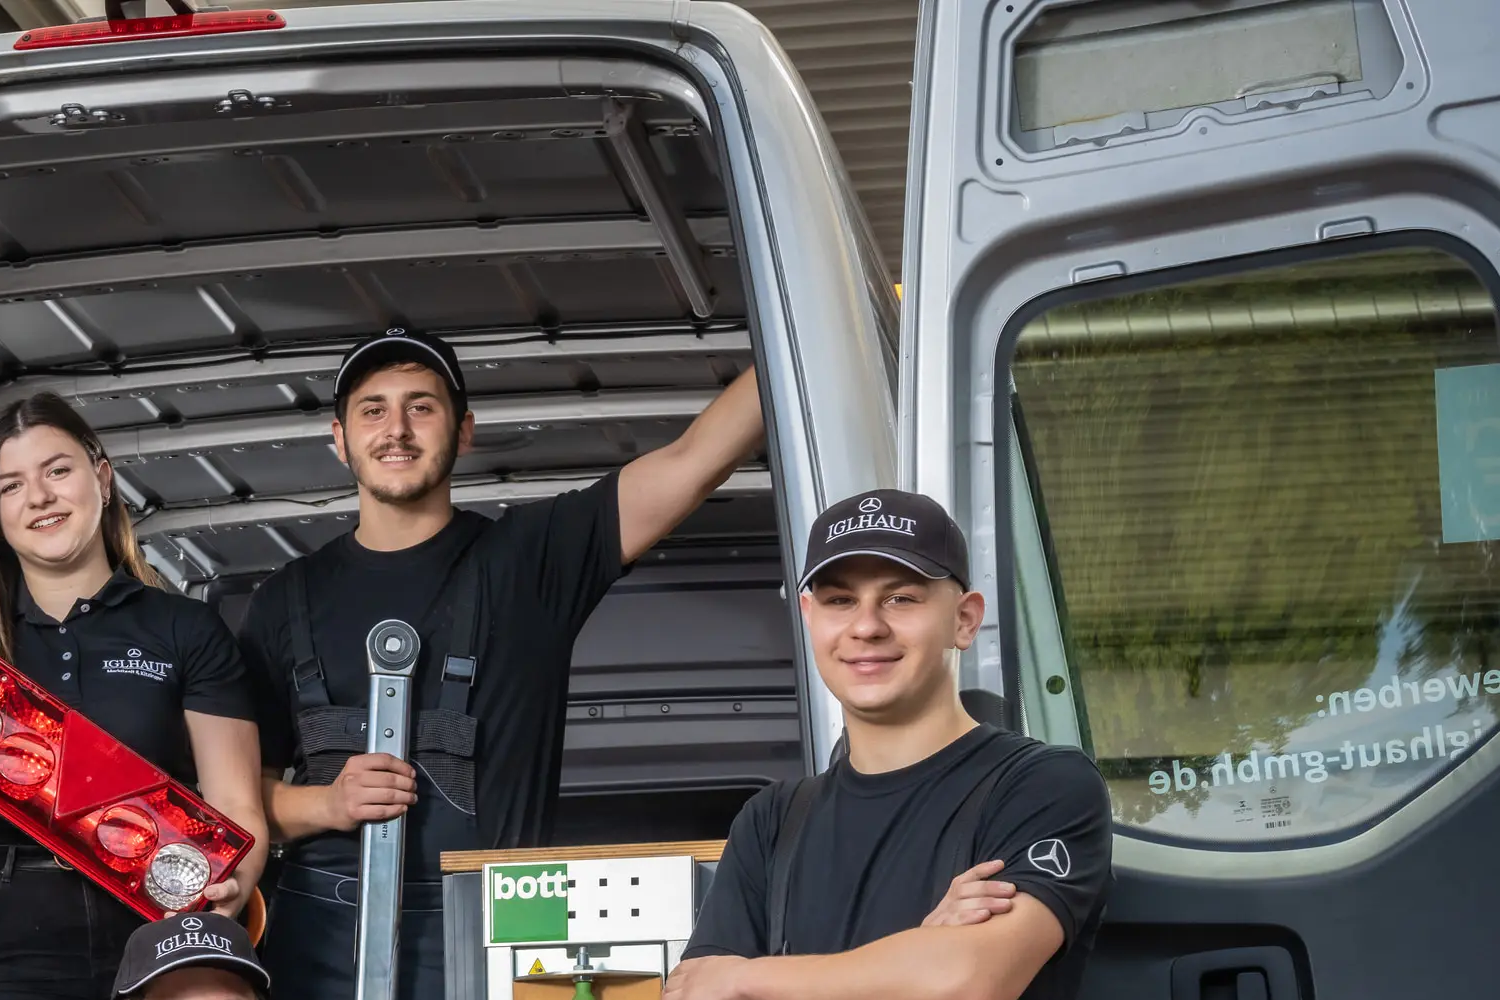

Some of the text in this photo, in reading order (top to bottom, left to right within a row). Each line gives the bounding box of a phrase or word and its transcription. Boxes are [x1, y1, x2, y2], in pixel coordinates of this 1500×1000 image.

[826, 513, 917, 540] IGLHAUT
[494, 869, 568, 900] bott
[155, 932, 232, 957] IGLHAUT
